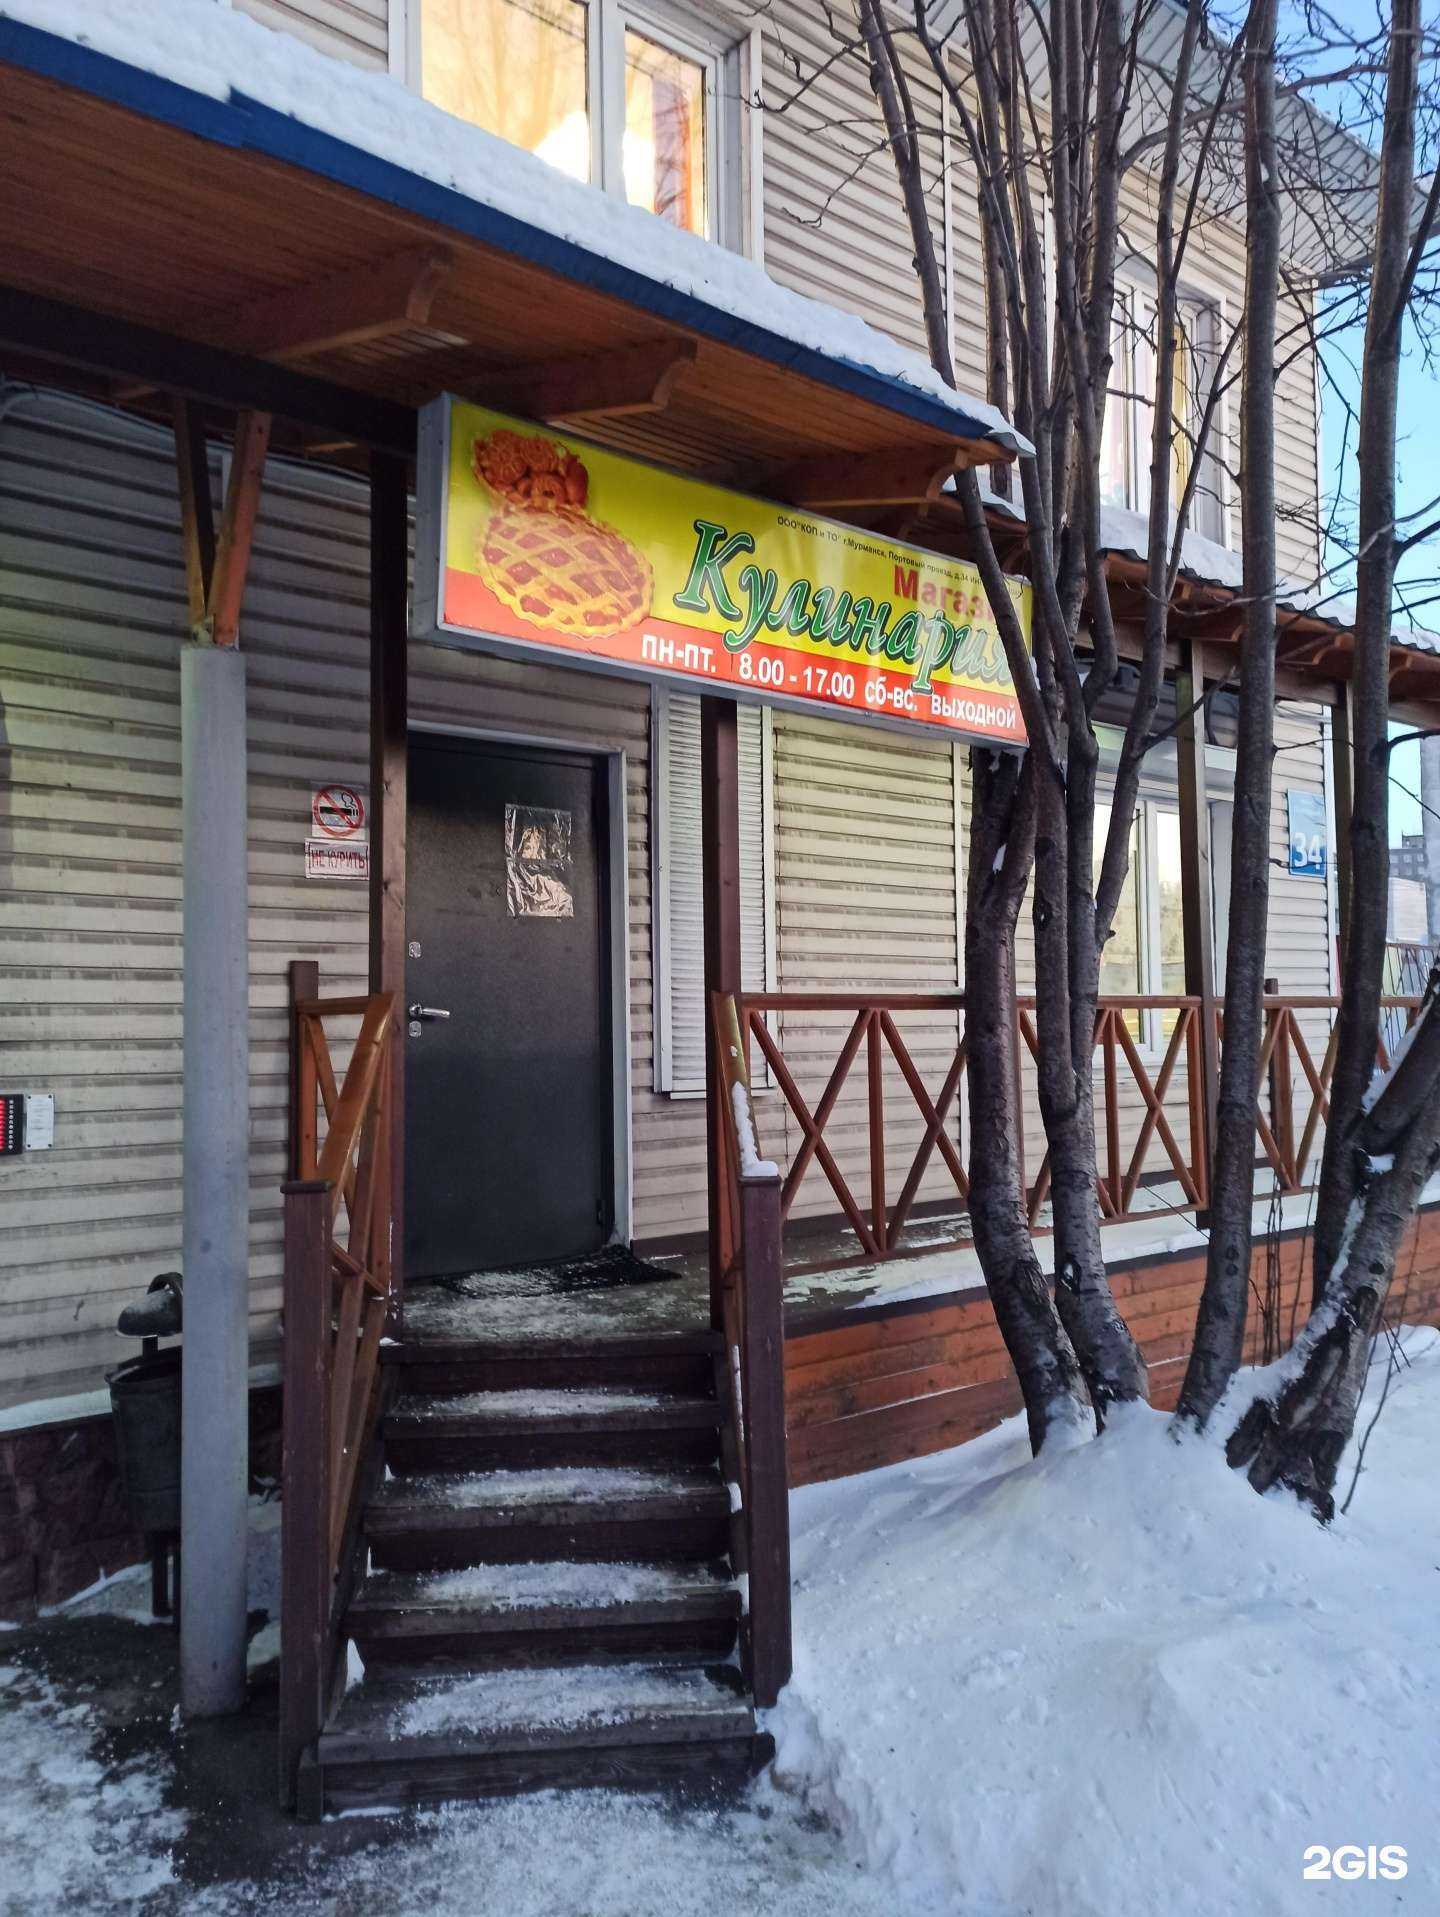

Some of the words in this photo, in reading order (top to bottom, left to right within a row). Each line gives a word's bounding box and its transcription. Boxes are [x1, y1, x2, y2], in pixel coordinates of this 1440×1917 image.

[888, 550, 926, 570] Портовый
[893, 564, 995, 623] Магаз
[738, 653, 785, 686] 8.00
[802, 665, 856, 700] 17.00
[311, 849, 325, 868] НЕ
[327, 850, 365, 869] КУРИТЬ
[1293, 831, 1323, 870] 34
